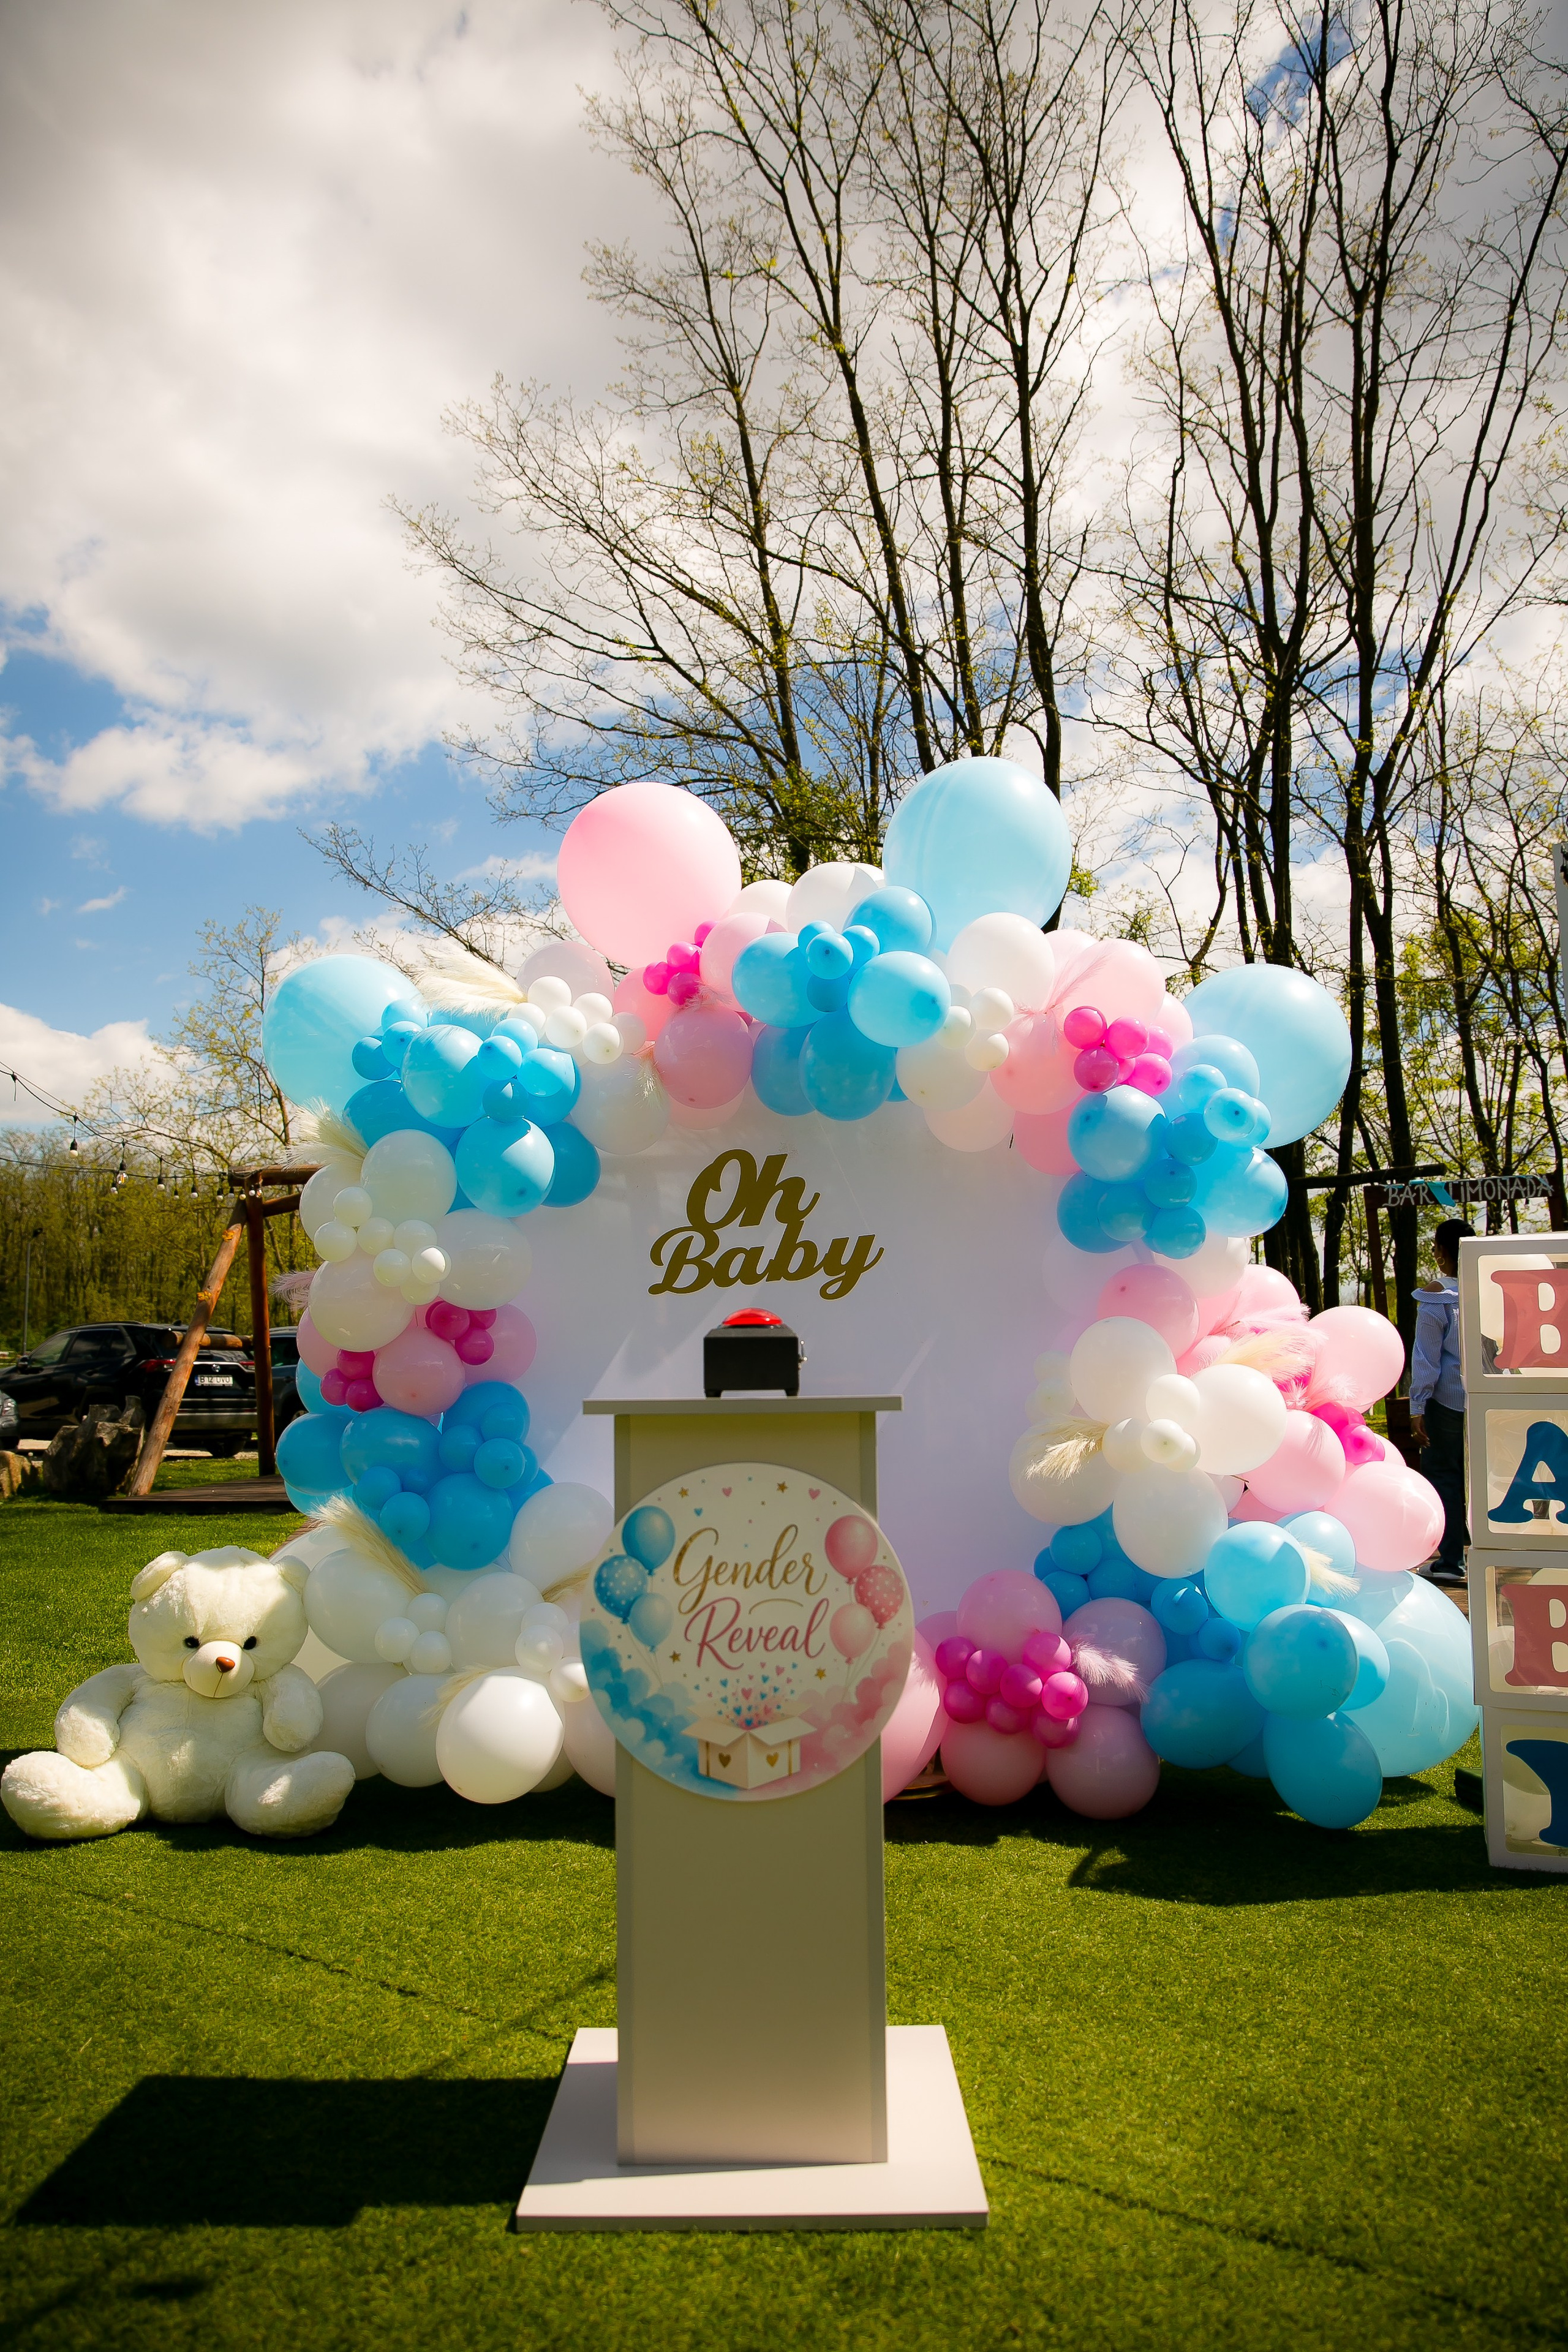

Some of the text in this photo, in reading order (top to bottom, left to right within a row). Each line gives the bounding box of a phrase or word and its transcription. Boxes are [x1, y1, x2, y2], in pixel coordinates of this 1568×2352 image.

[686, 1148, 821, 1231] Oh
[1382, 1183, 1434, 1207] BAR
[647, 1221, 884, 1300] Baby
[673, 1524, 827, 1615] Gender
[684, 1596, 829, 1671] Reveal
